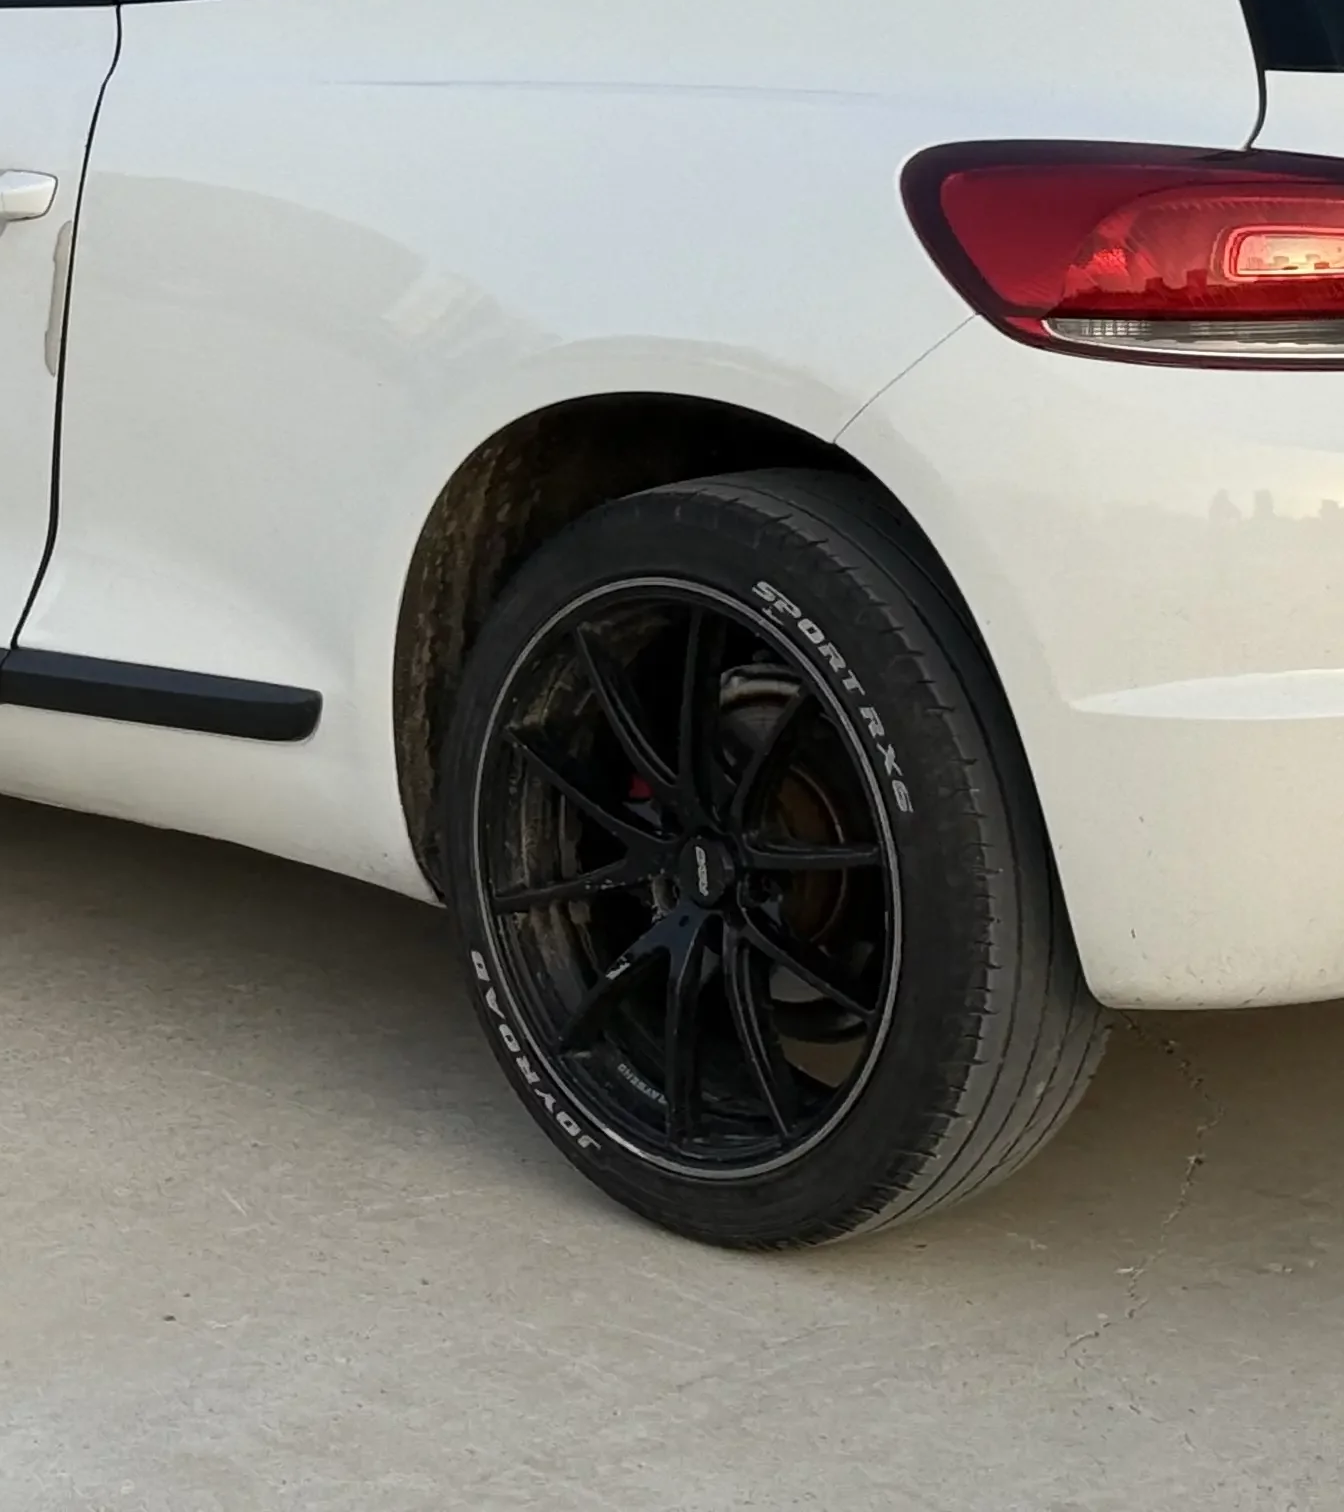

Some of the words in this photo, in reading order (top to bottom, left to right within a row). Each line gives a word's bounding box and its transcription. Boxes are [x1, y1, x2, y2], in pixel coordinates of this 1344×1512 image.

[751, 580, 866, 696] SPORT
[859, 706, 914, 813] RX6
[471, 950, 602, 1151] JOYROAD
